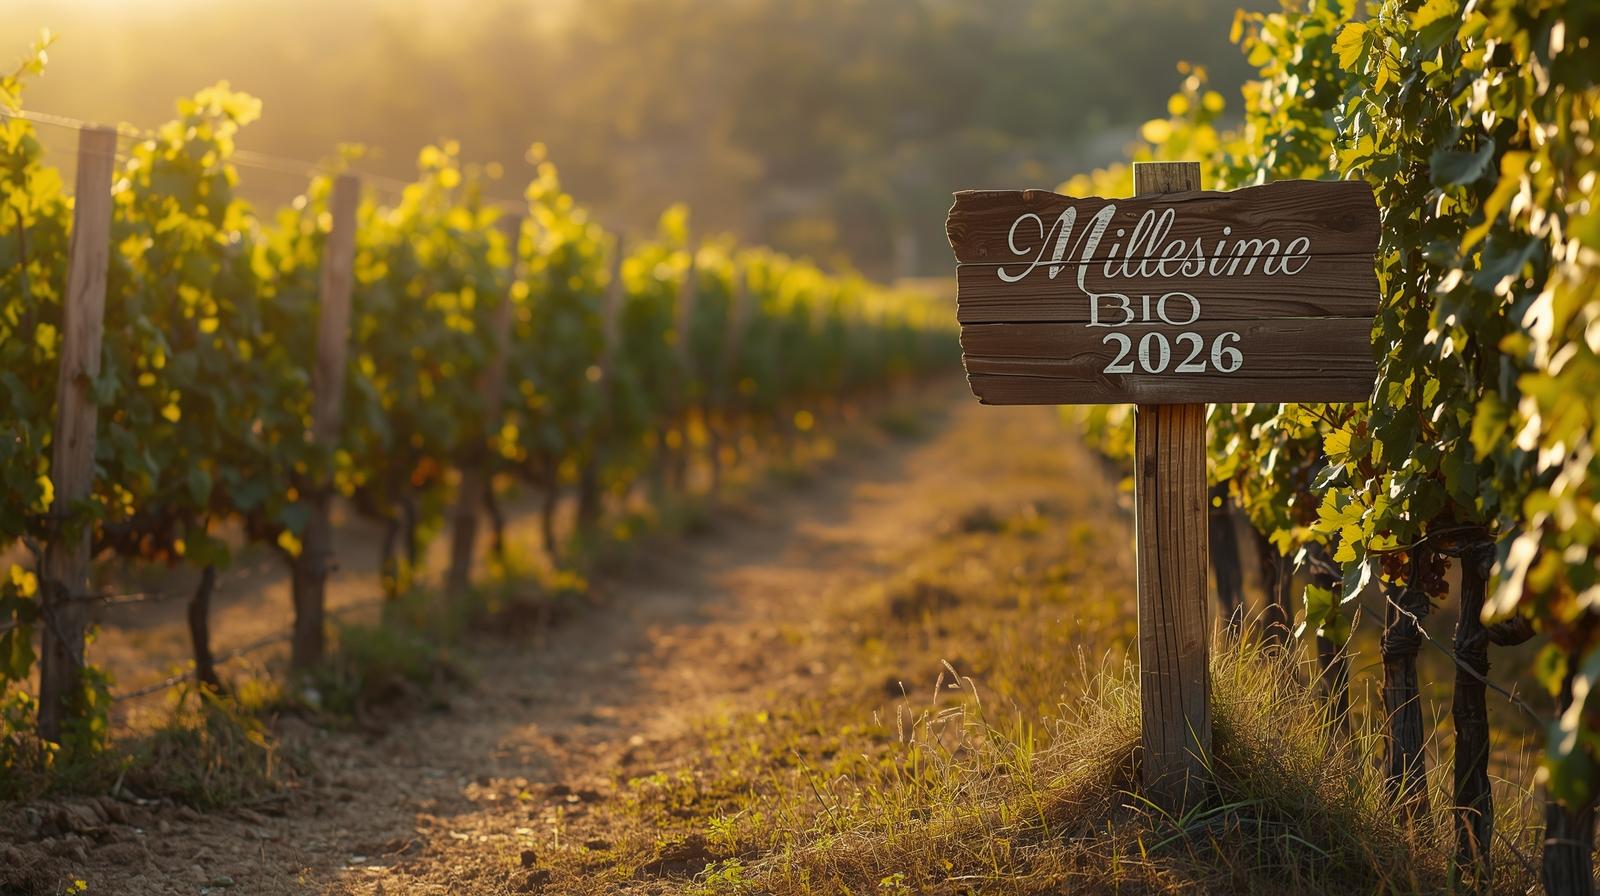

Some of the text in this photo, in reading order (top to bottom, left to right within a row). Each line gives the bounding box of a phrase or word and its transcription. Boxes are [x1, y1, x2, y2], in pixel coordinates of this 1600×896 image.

[997, 204, 1312, 291] Millesime
[1085, 291, 1201, 327] BIO
[1102, 331, 1244, 374] 2026
